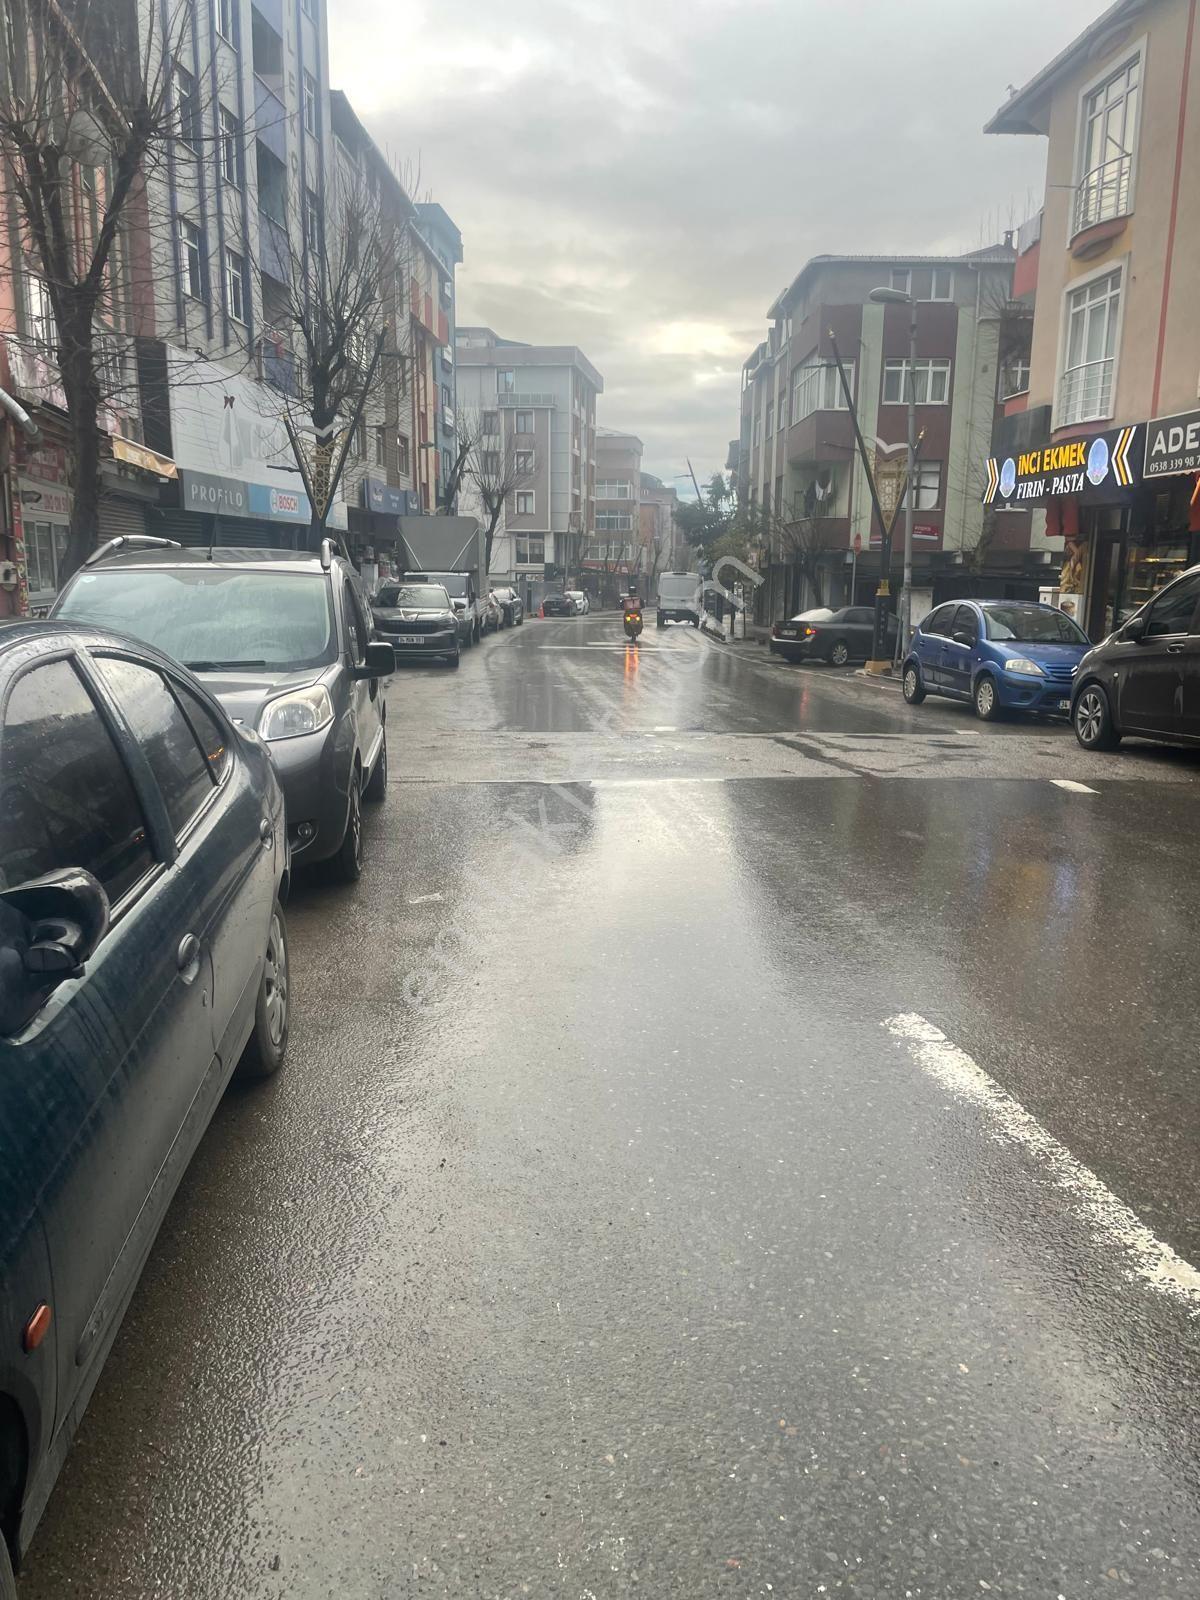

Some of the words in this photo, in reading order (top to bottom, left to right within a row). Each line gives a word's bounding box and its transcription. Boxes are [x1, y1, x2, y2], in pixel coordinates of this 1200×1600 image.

[1043, 441, 1087, 472] EKMEK
[1149, 462, 1168, 473] 0538
[1170, 458, 1183, 470] 339
[1184, 456, 1194, 467] 98
[1016, 479, 1046, 499] FIRIN
[1051, 472, 1085, 495] PASTA
[279, 495, 298, 513] BOSCH
